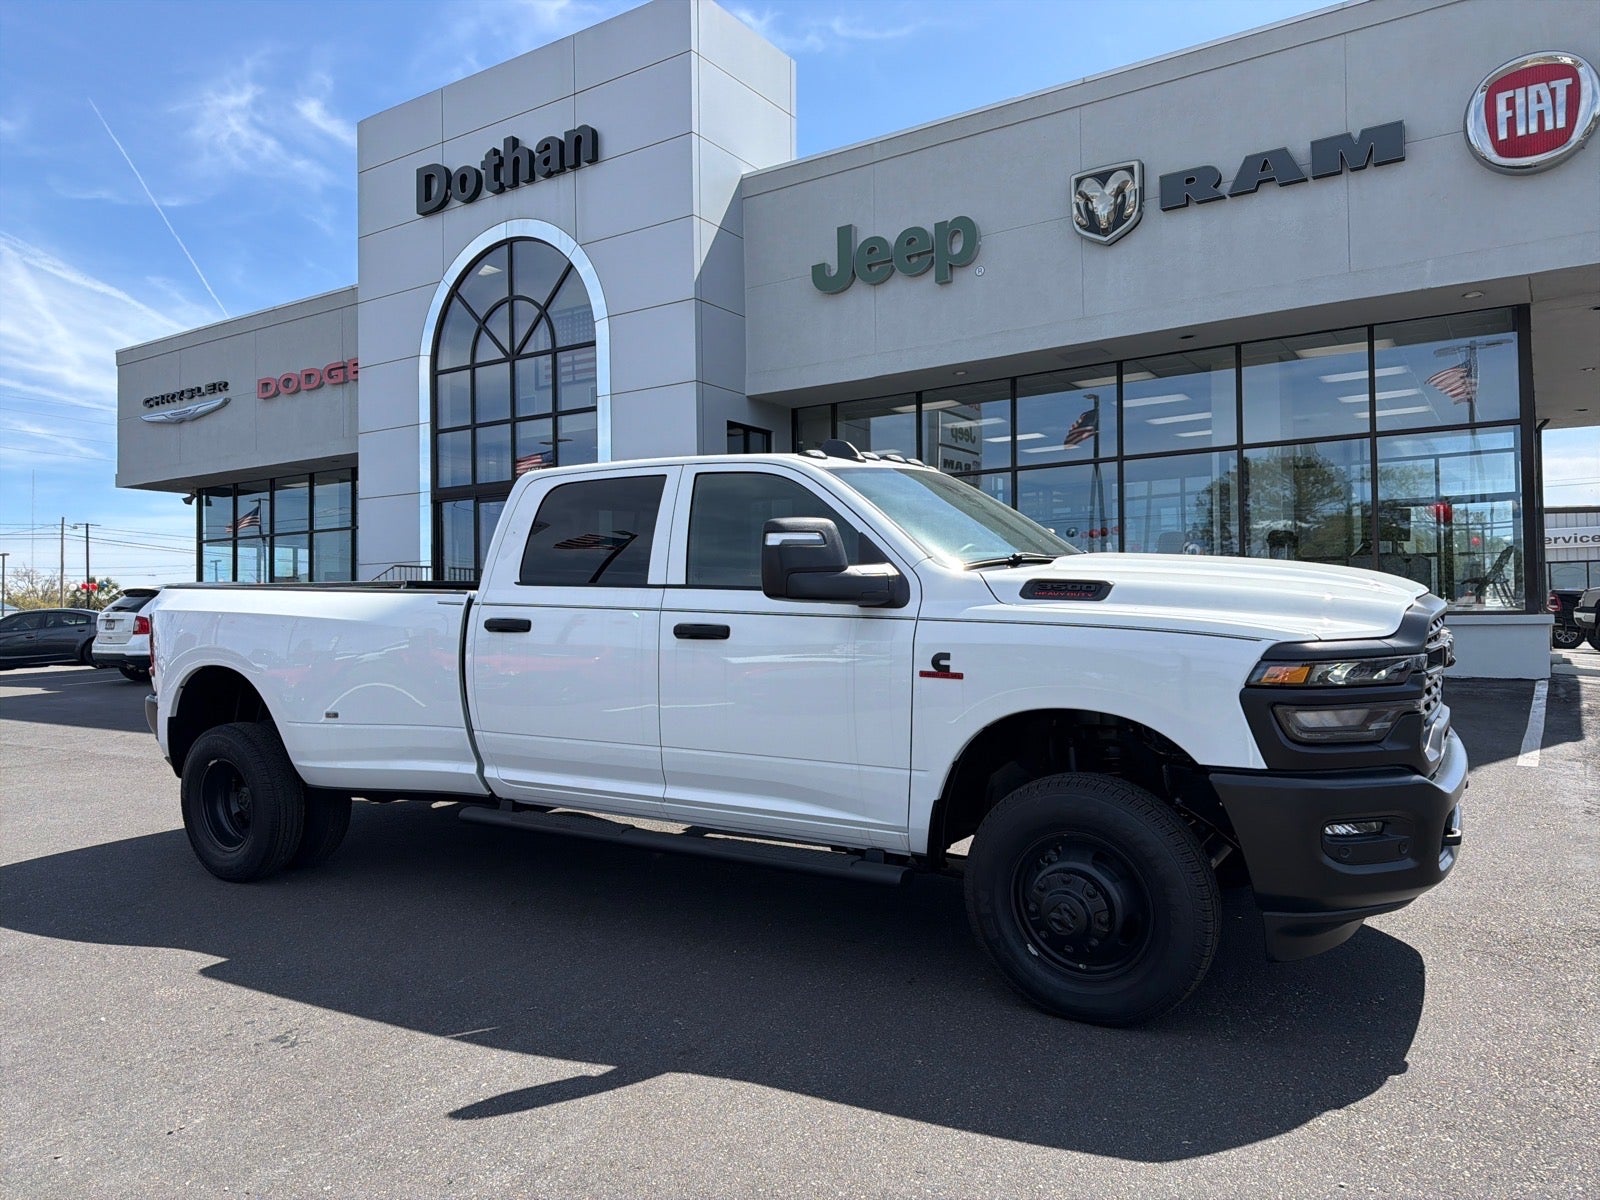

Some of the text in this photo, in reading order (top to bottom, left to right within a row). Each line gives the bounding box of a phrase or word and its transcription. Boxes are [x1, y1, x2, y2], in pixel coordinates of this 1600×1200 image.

[1496, 78, 1573, 141] FIAT
[416, 124, 599, 216] Dothan
[1159, 120, 1406, 212] RAM
[811, 215, 981, 294] Jeep
[143, 381, 230, 408] CHRYSLER
[257, 357, 358, 400] DODGE
[1544, 533, 1600, 545] ervice
[1038, 583, 1096, 592] 3500
